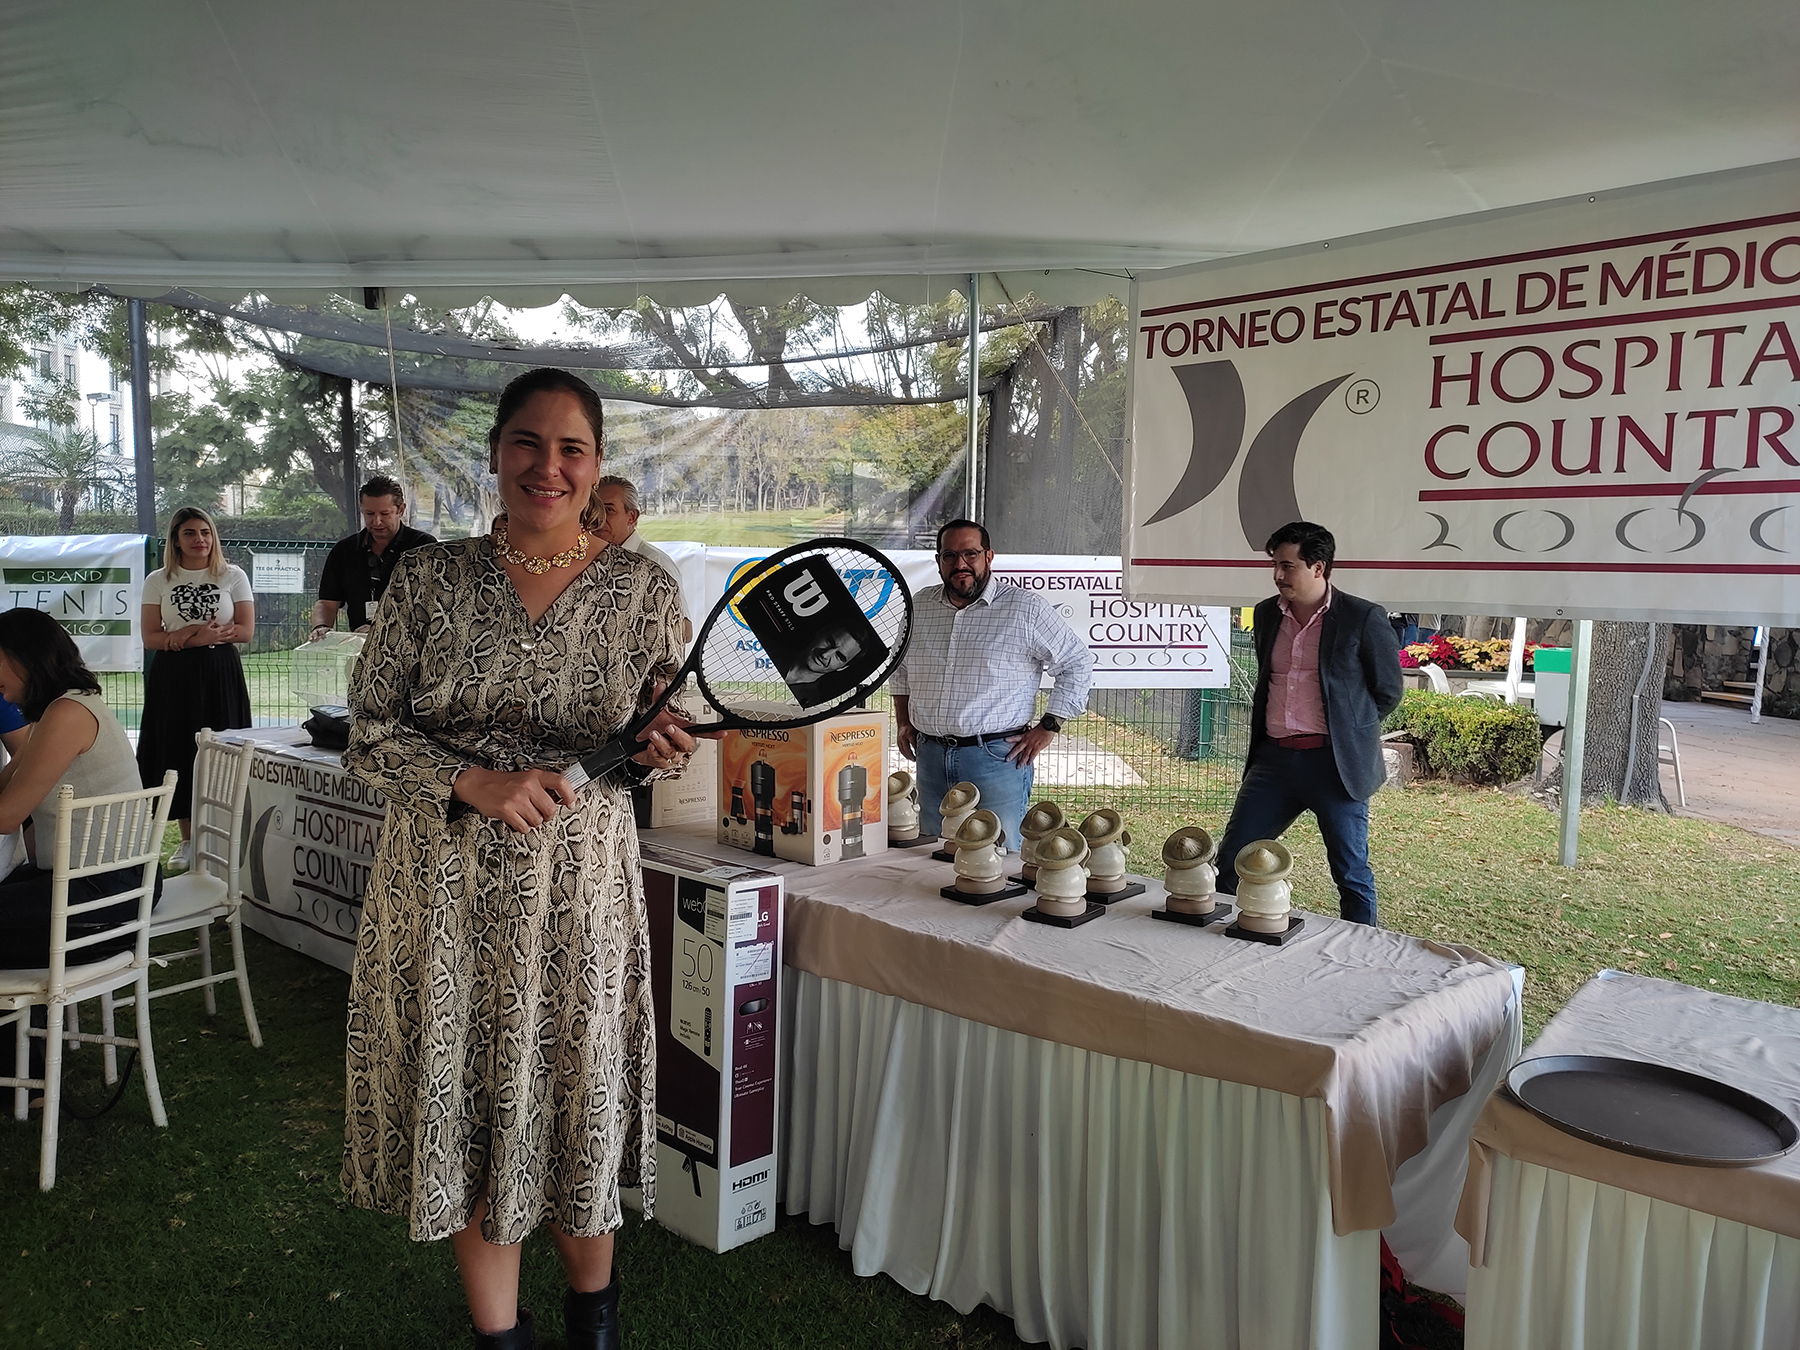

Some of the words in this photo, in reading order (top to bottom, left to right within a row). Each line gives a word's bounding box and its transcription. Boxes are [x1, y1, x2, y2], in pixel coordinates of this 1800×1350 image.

[1140, 306, 1306, 359] TORNEO
[1313, 278, 1506, 340] ESTATAL
[1516, 264, 1590, 316] DE
[1599, 236, 1800, 306] MÉDIC
[1429, 321, 1800, 409] HOSPITA
[1424, 404, 1800, 480] COUNTR
[32, 571, 102, 582] GRAND
[1048, 576, 1113, 590] ESTATAL
[9, 590, 128, 615] TENIS
[766, 590, 774, 600] PRO
[774, 601, 786, 617] STAFF
[60, 623, 105, 635] XICO
[1089, 623, 1207, 642] COUNTRY
[736, 640, 763, 651] ASO
[740, 728, 789, 742] NESPRESSO
[830, 729, 875, 744] NESPRESSO
[266, 761, 312, 792] ESTATAL
[314, 770, 330, 796] DE
[682, 938, 713, 983] 50
[682, 979, 692, 990] 126
[702, 986, 710, 996] 50
[732, 1169, 770, 1191] HDMI
